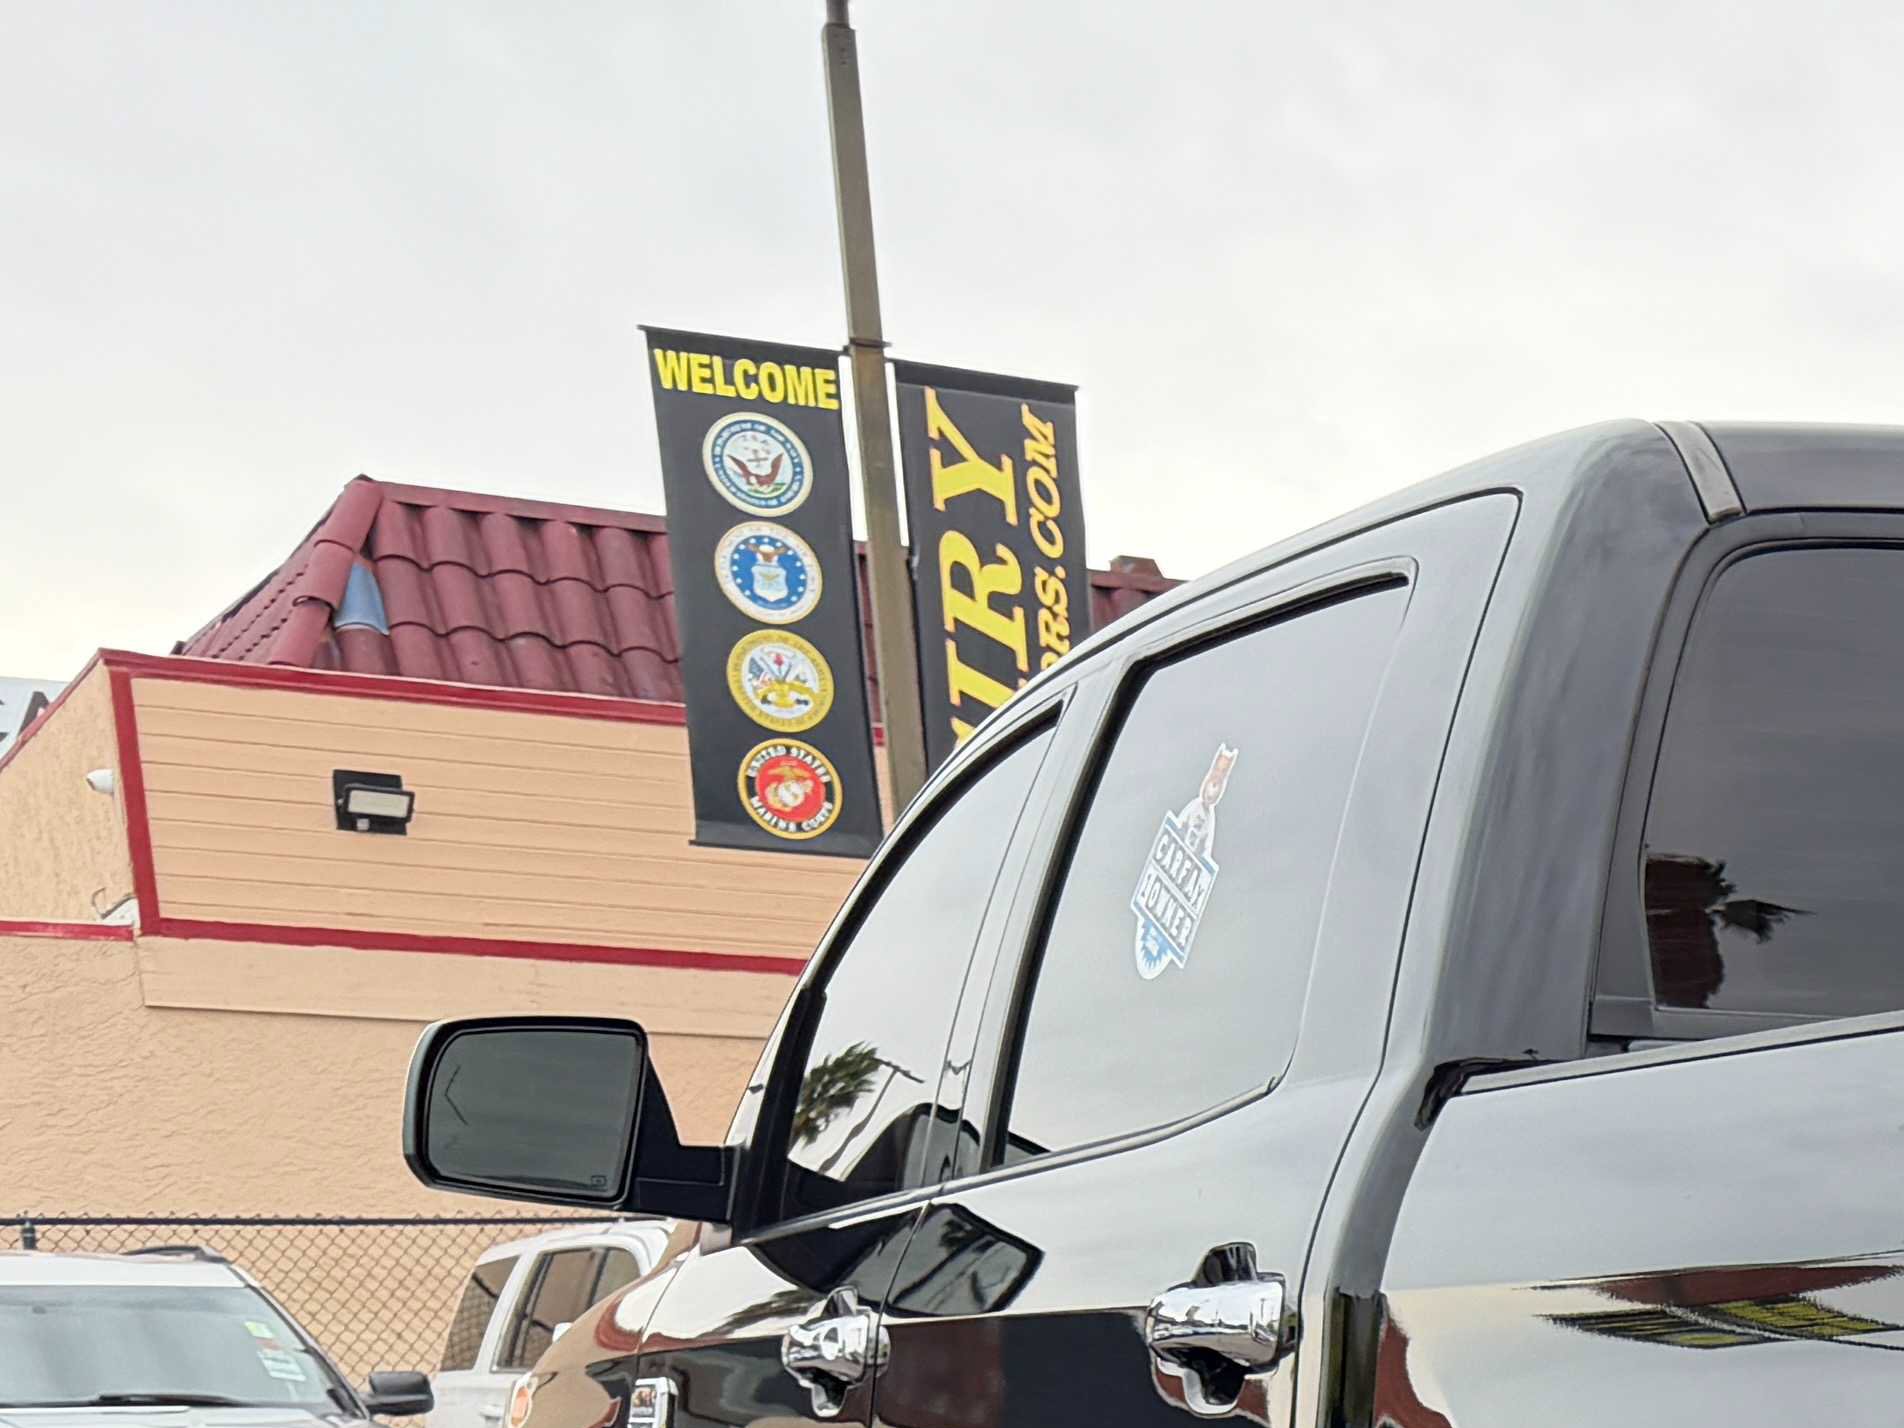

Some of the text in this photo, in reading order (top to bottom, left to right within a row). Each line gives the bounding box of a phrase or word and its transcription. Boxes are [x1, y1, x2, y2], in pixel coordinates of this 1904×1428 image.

[654, 348, 839, 410] WELCOME
[926, 385, 1030, 749] IRY
[747, 745, 832, 784] UNITED STATES
[750, 796, 797, 833] MARINE
[1156, 832, 1206, 912] CARFAX
[1150, 881, 1193, 946] OWNER
